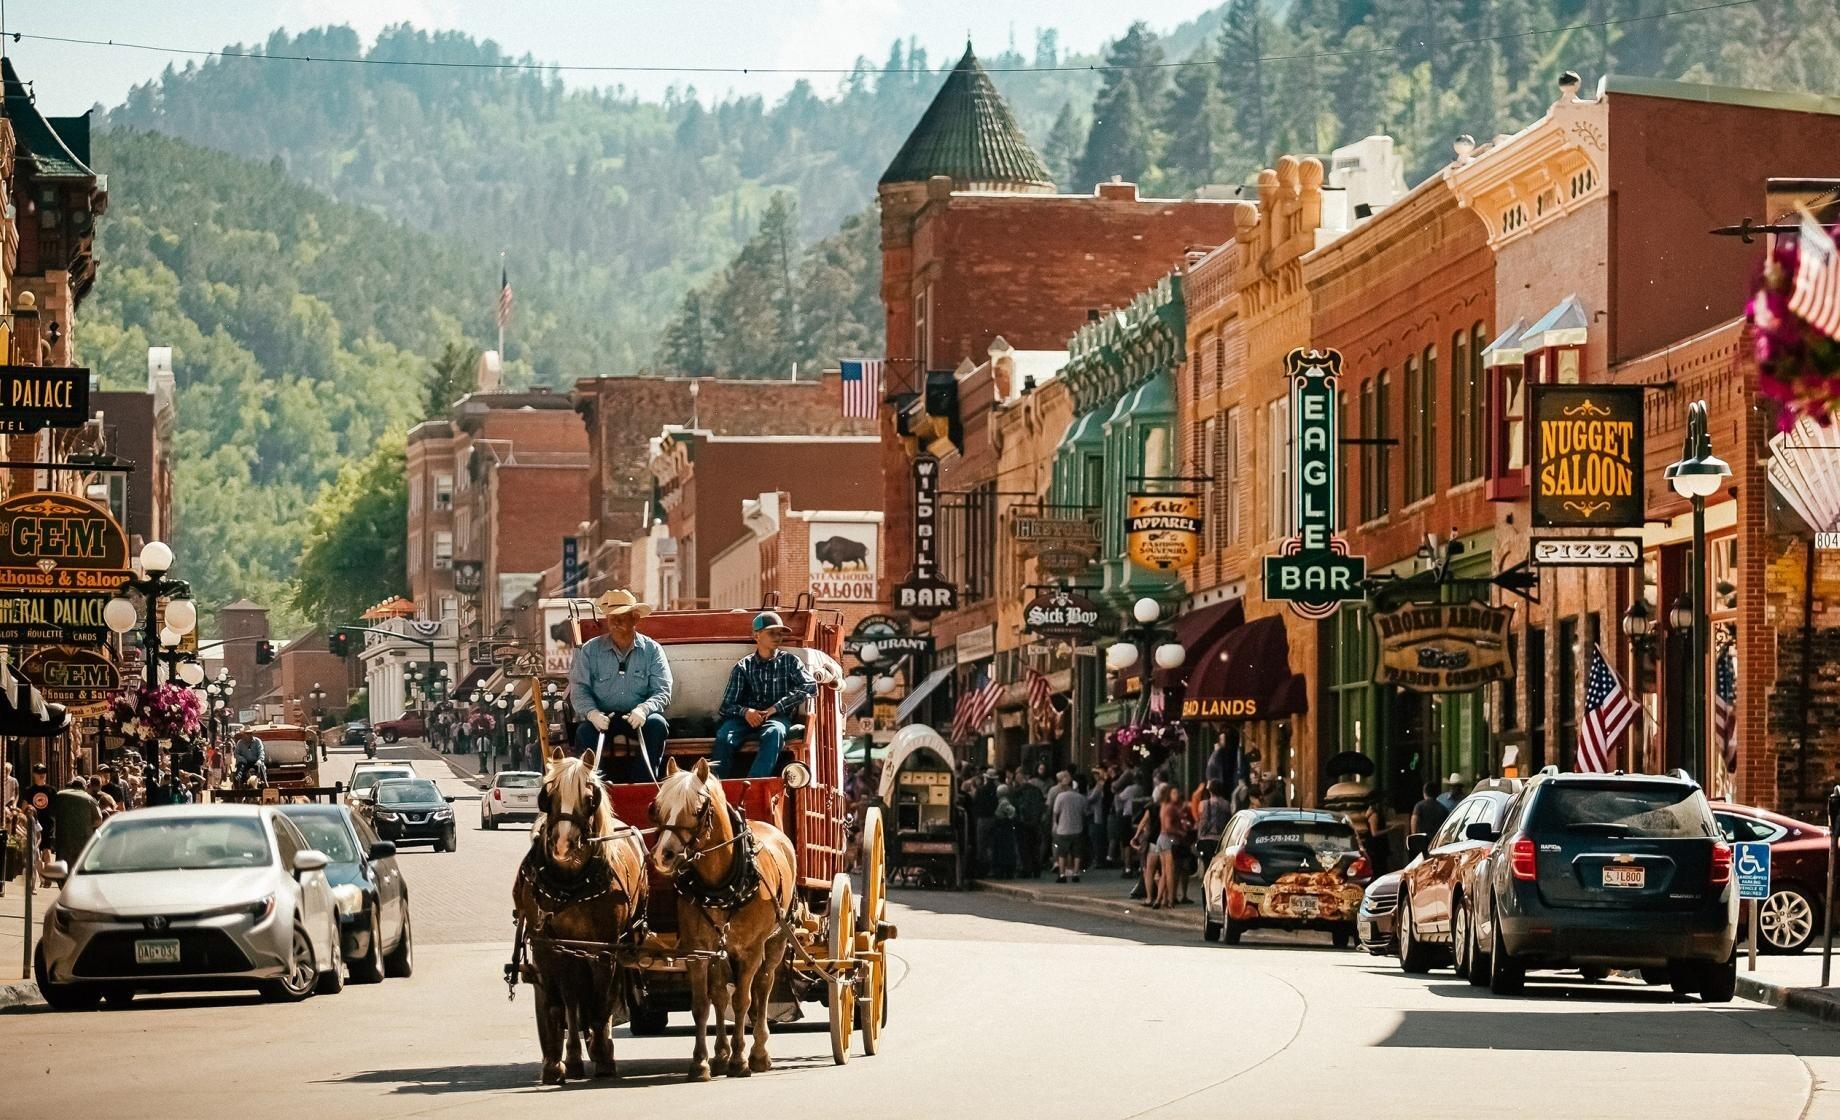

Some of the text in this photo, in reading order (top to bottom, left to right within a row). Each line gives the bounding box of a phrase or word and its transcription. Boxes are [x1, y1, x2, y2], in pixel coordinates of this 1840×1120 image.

[12, 379, 73, 408] PALACE
[1541, 420, 1633, 464] NUGGET
[1303, 395, 1327, 549] EAGLE
[1541, 453, 1633, 496] SALOON
[917, 463, 934, 579] WILD BILL
[1133, 517, 1196, 531] APPAREL
[11, 516, 107, 558] GEM
[1817, 533, 1838, 548] 804
[1537, 544, 1635, 559] PIZZA
[58, 570, 72, 586] &
[1281, 566, 1351, 590] BAR
[812, 582, 874, 599] SALOON
[901, 588, 952, 606] BAR
[53, 598, 105, 626] PALACE
[1027, 605, 1098, 627] Sick Boy
[0, 630, 97, 641] LOTS ROULETTE CARDS
[843, 639, 928, 651] ESTAURANT
[44, 660, 110, 688] GEM
[1201, 699, 1257, 716] LANDS
